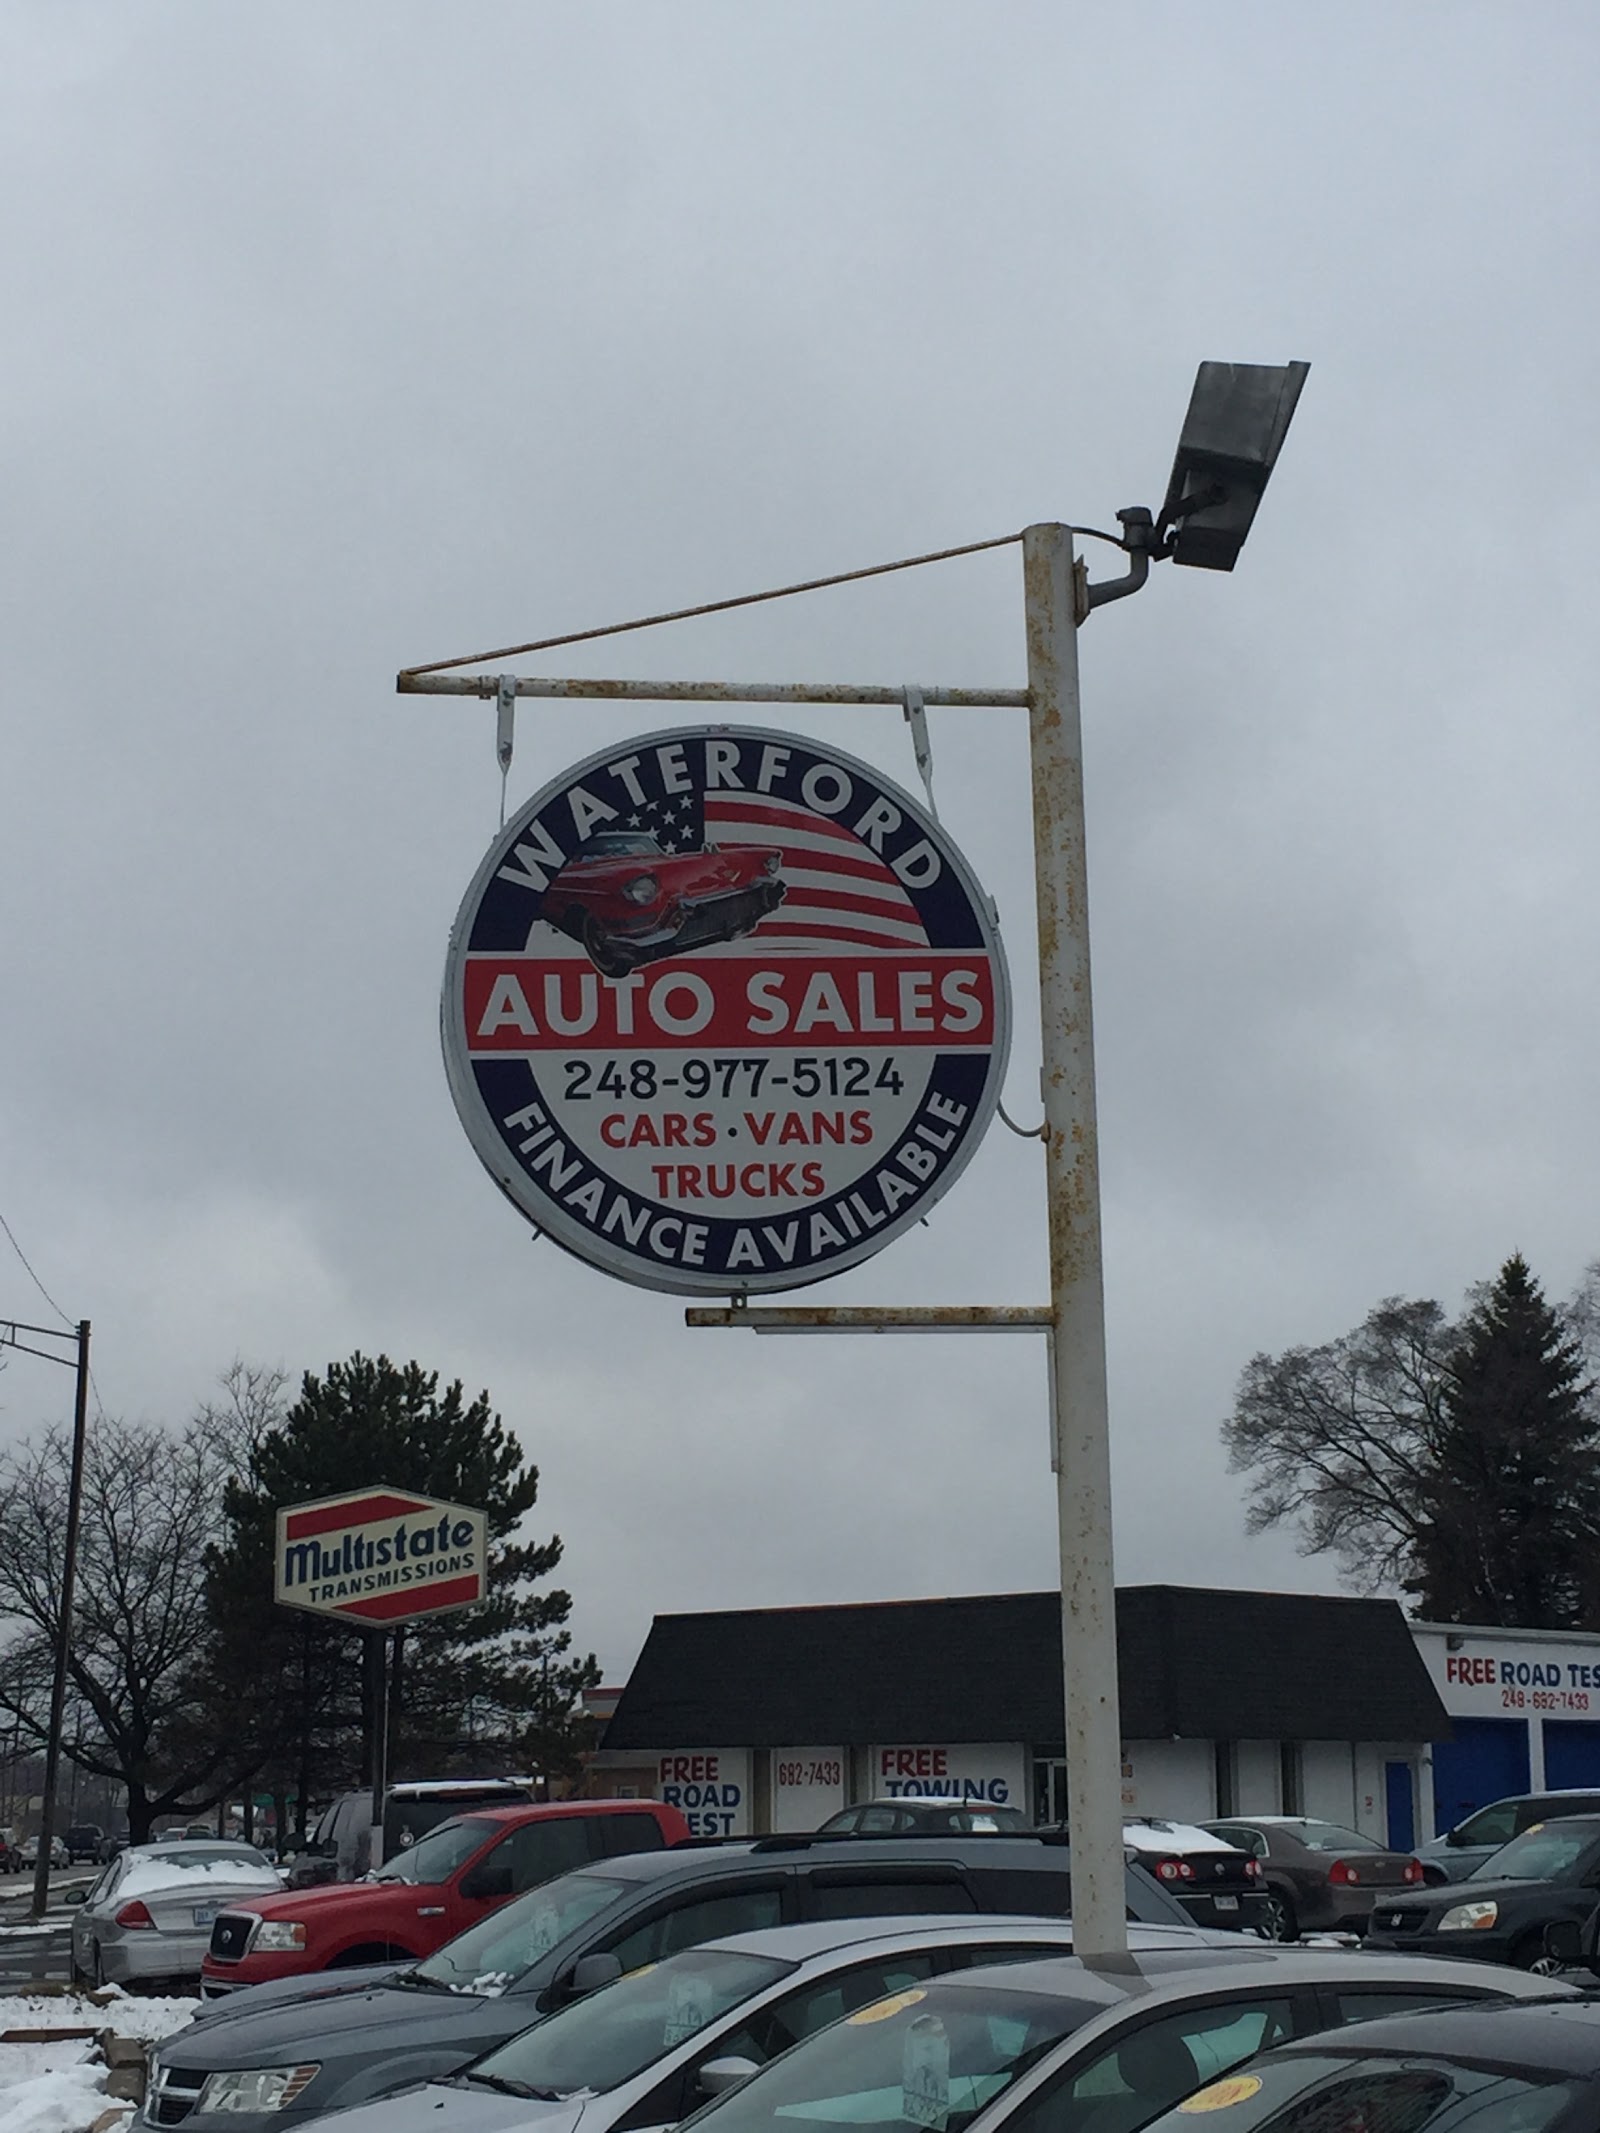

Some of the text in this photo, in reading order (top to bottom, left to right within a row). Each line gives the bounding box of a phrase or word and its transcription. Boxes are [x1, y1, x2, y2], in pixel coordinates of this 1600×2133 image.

[500, 740, 941, 893] WATERFORD
[477, 970, 983, 1036] AUTO SALES
[563, 1057, 904, 1100] 248-977-5124
[600, 1110, 873, 1148] CARS VANS
[503, 1090, 968, 1269] FINANCE AVAILABLE
[652, 1162, 825, 1199] TRUCKS
[284, 1513, 474, 1587] Multistate
[308, 1552, 475, 1602] TRANSMISSIONS
[1446, 1657, 1496, 1686] FREE
[1501, 1661, 1561, 1687] ROAD
[660, 1756, 719, 1783] FREE
[778, 1761, 841, 1786] 682-7433
[881, 1749, 948, 1777] FREE
[663, 1784, 741, 1808] ROAD
[885, 1778, 1009, 1803] TOWING
[682, 1812, 736, 1836] EST
